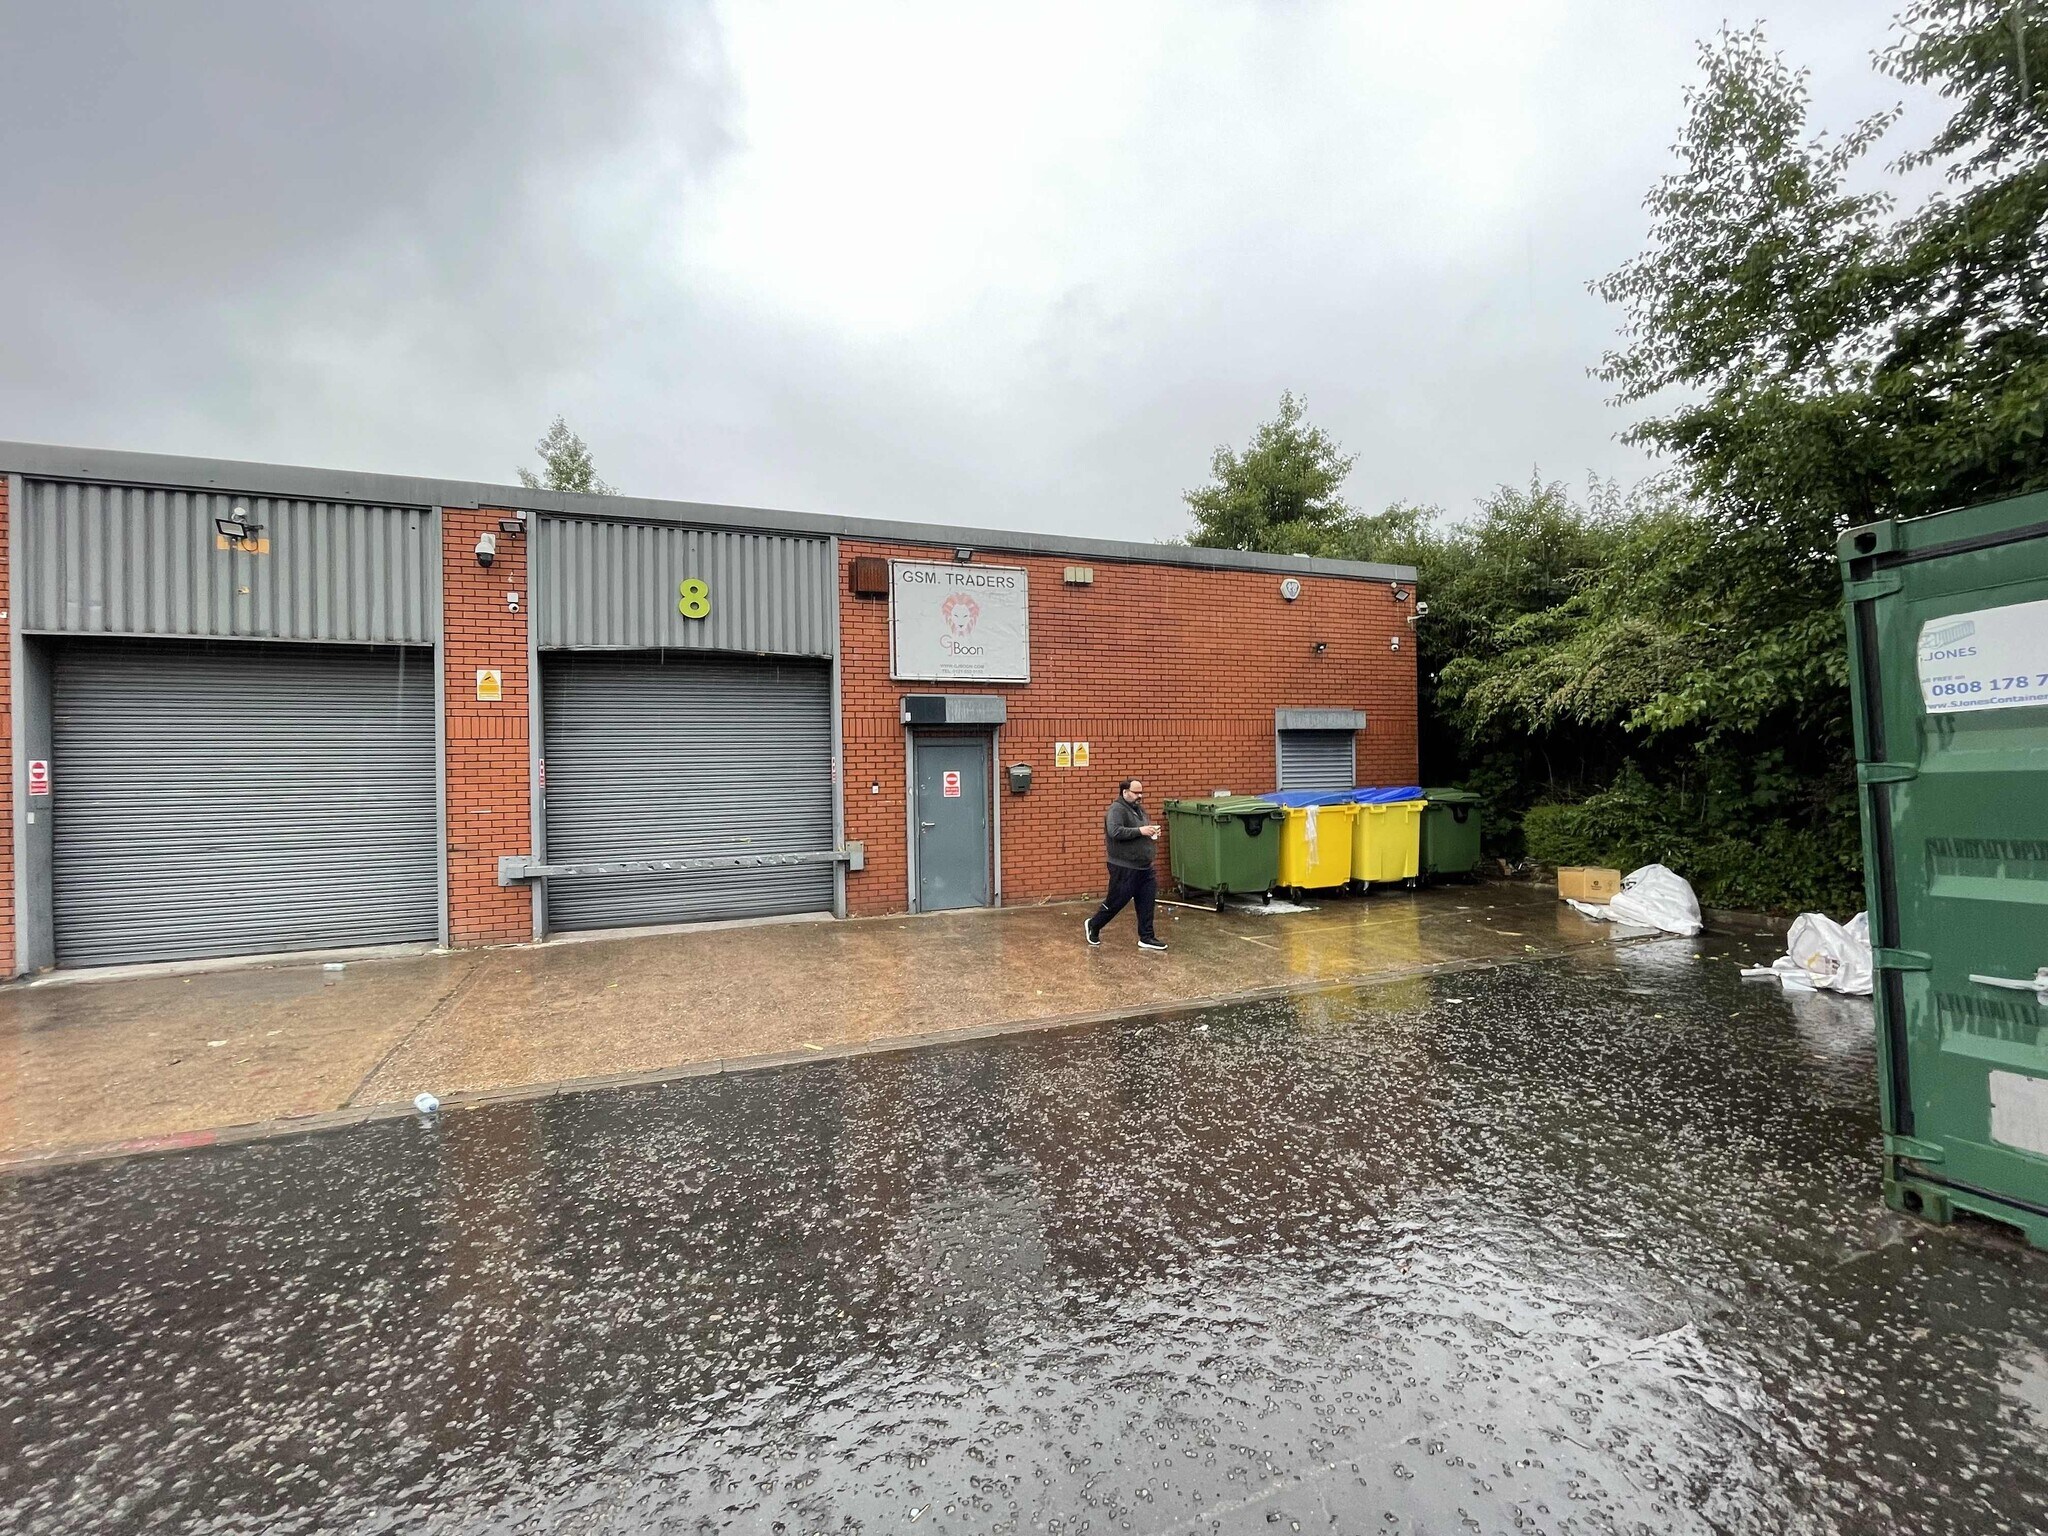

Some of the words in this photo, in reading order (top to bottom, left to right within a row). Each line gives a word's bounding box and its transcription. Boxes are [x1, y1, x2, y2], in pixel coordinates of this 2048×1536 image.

[902, 570, 941, 584] GSM.
[945, 573, 1015, 589] TRADERS
[679, 578, 711, 619] 8
[1932, 680, 1982, 697] 0808
[1990, 675, 2029, 691] 178
